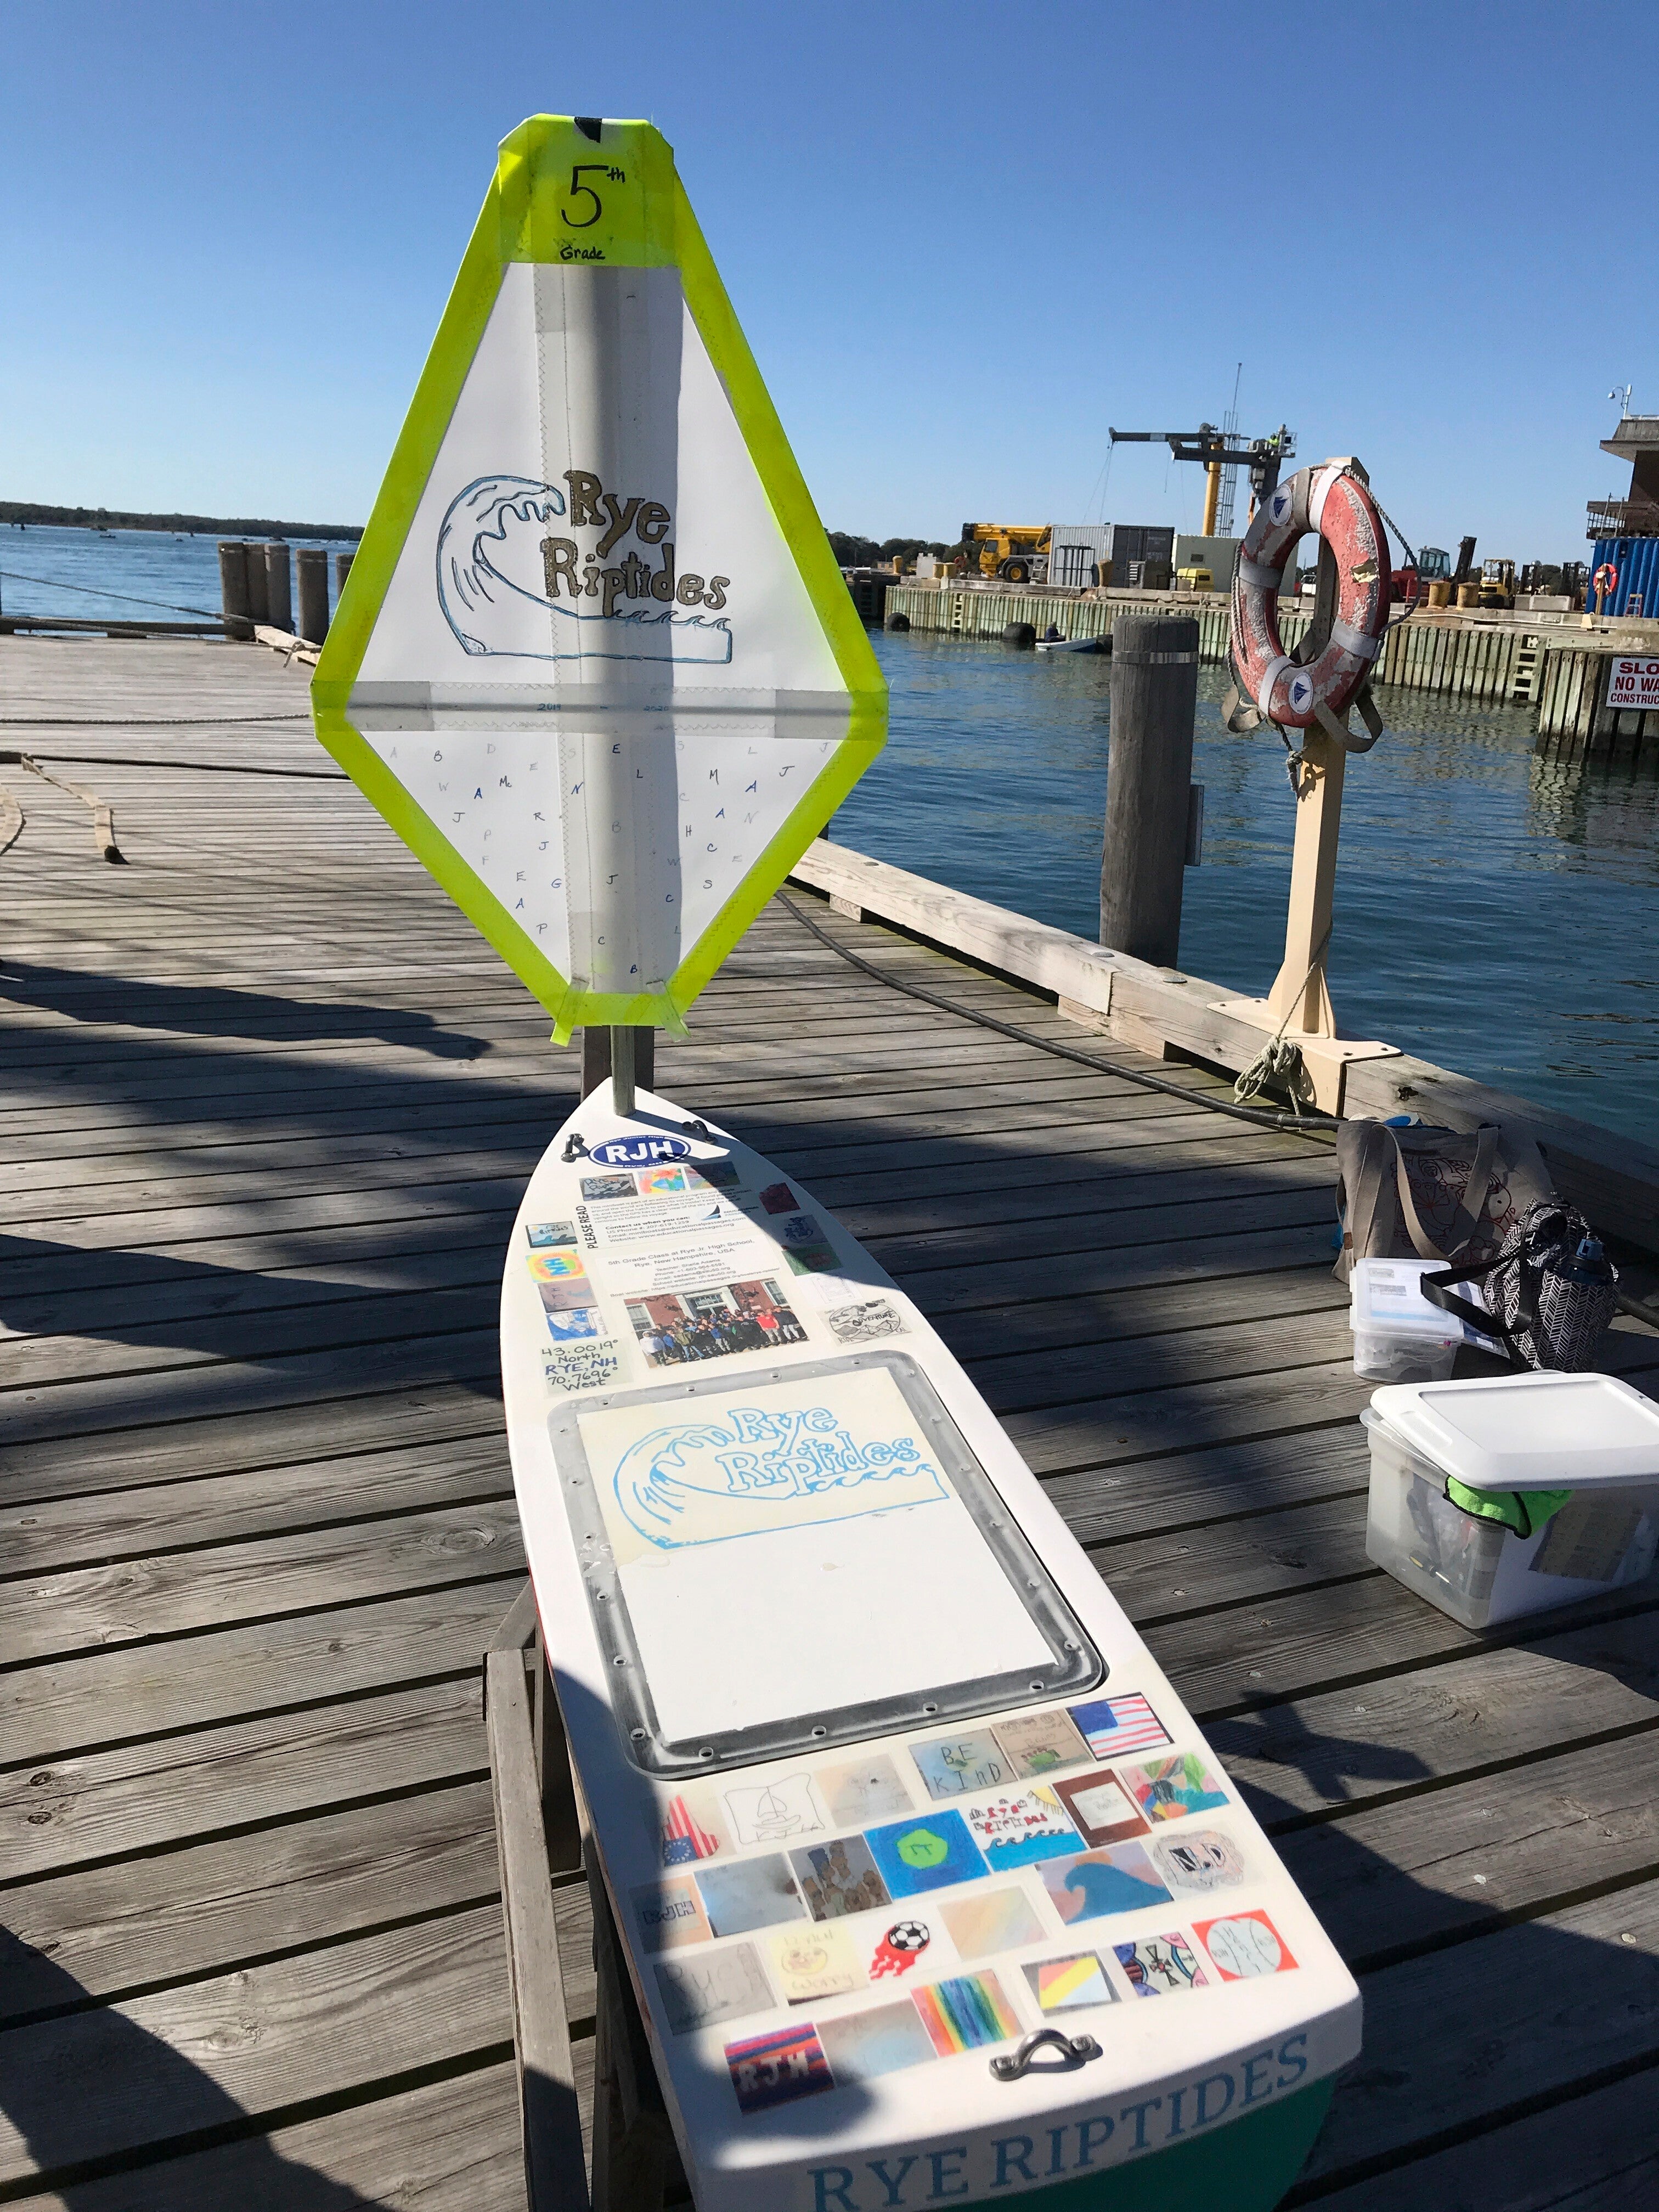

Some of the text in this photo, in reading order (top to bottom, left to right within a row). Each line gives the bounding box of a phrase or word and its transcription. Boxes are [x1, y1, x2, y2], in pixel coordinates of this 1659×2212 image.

[561, 165, 625, 227] 5th
[560, 245, 605, 260] Grade
[562, 469, 670, 558] Rye
[539, 537, 731, 618] Riptides
[1615, 676, 1635, 691] NO
[487, 743, 495, 754] D
[612, 743, 620, 753] E
[434, 751, 442, 762] B
[636, 769, 643, 778] L
[571, 782, 584, 794] N
[745, 780, 757, 792] A
[473, 788, 483, 799] A
[453, 812, 465, 822] J
[533, 811, 545, 821] R
[715, 808, 725, 819] A
[686, 825, 692, 837] H
[539, 841, 549, 851] J
[516, 871, 526, 882] E
[606, 874, 618, 885] J
[551, 878, 562, 888] G
[703, 879, 713, 889] S
[516, 898, 524, 909] A
[665, 894, 674, 902] C
[536, 923, 548, 934] P
[598, 936, 606, 945] C
[630, 964, 638, 974] B
[605, 1141, 673, 1163] RJH
[576, 1205, 599, 1249] PLEASE READ
[558, 1352, 601, 1364] North
[562, 1378, 606, 1391] West
[727, 1407, 839, 1456] Rye
[715, 1431, 921, 1497] Riptides
[940, 1742, 978, 1765] BE
[737, 2048, 812, 2093] RJH
[807, 2033, 1309, 2212] RYE RIPTIDES
